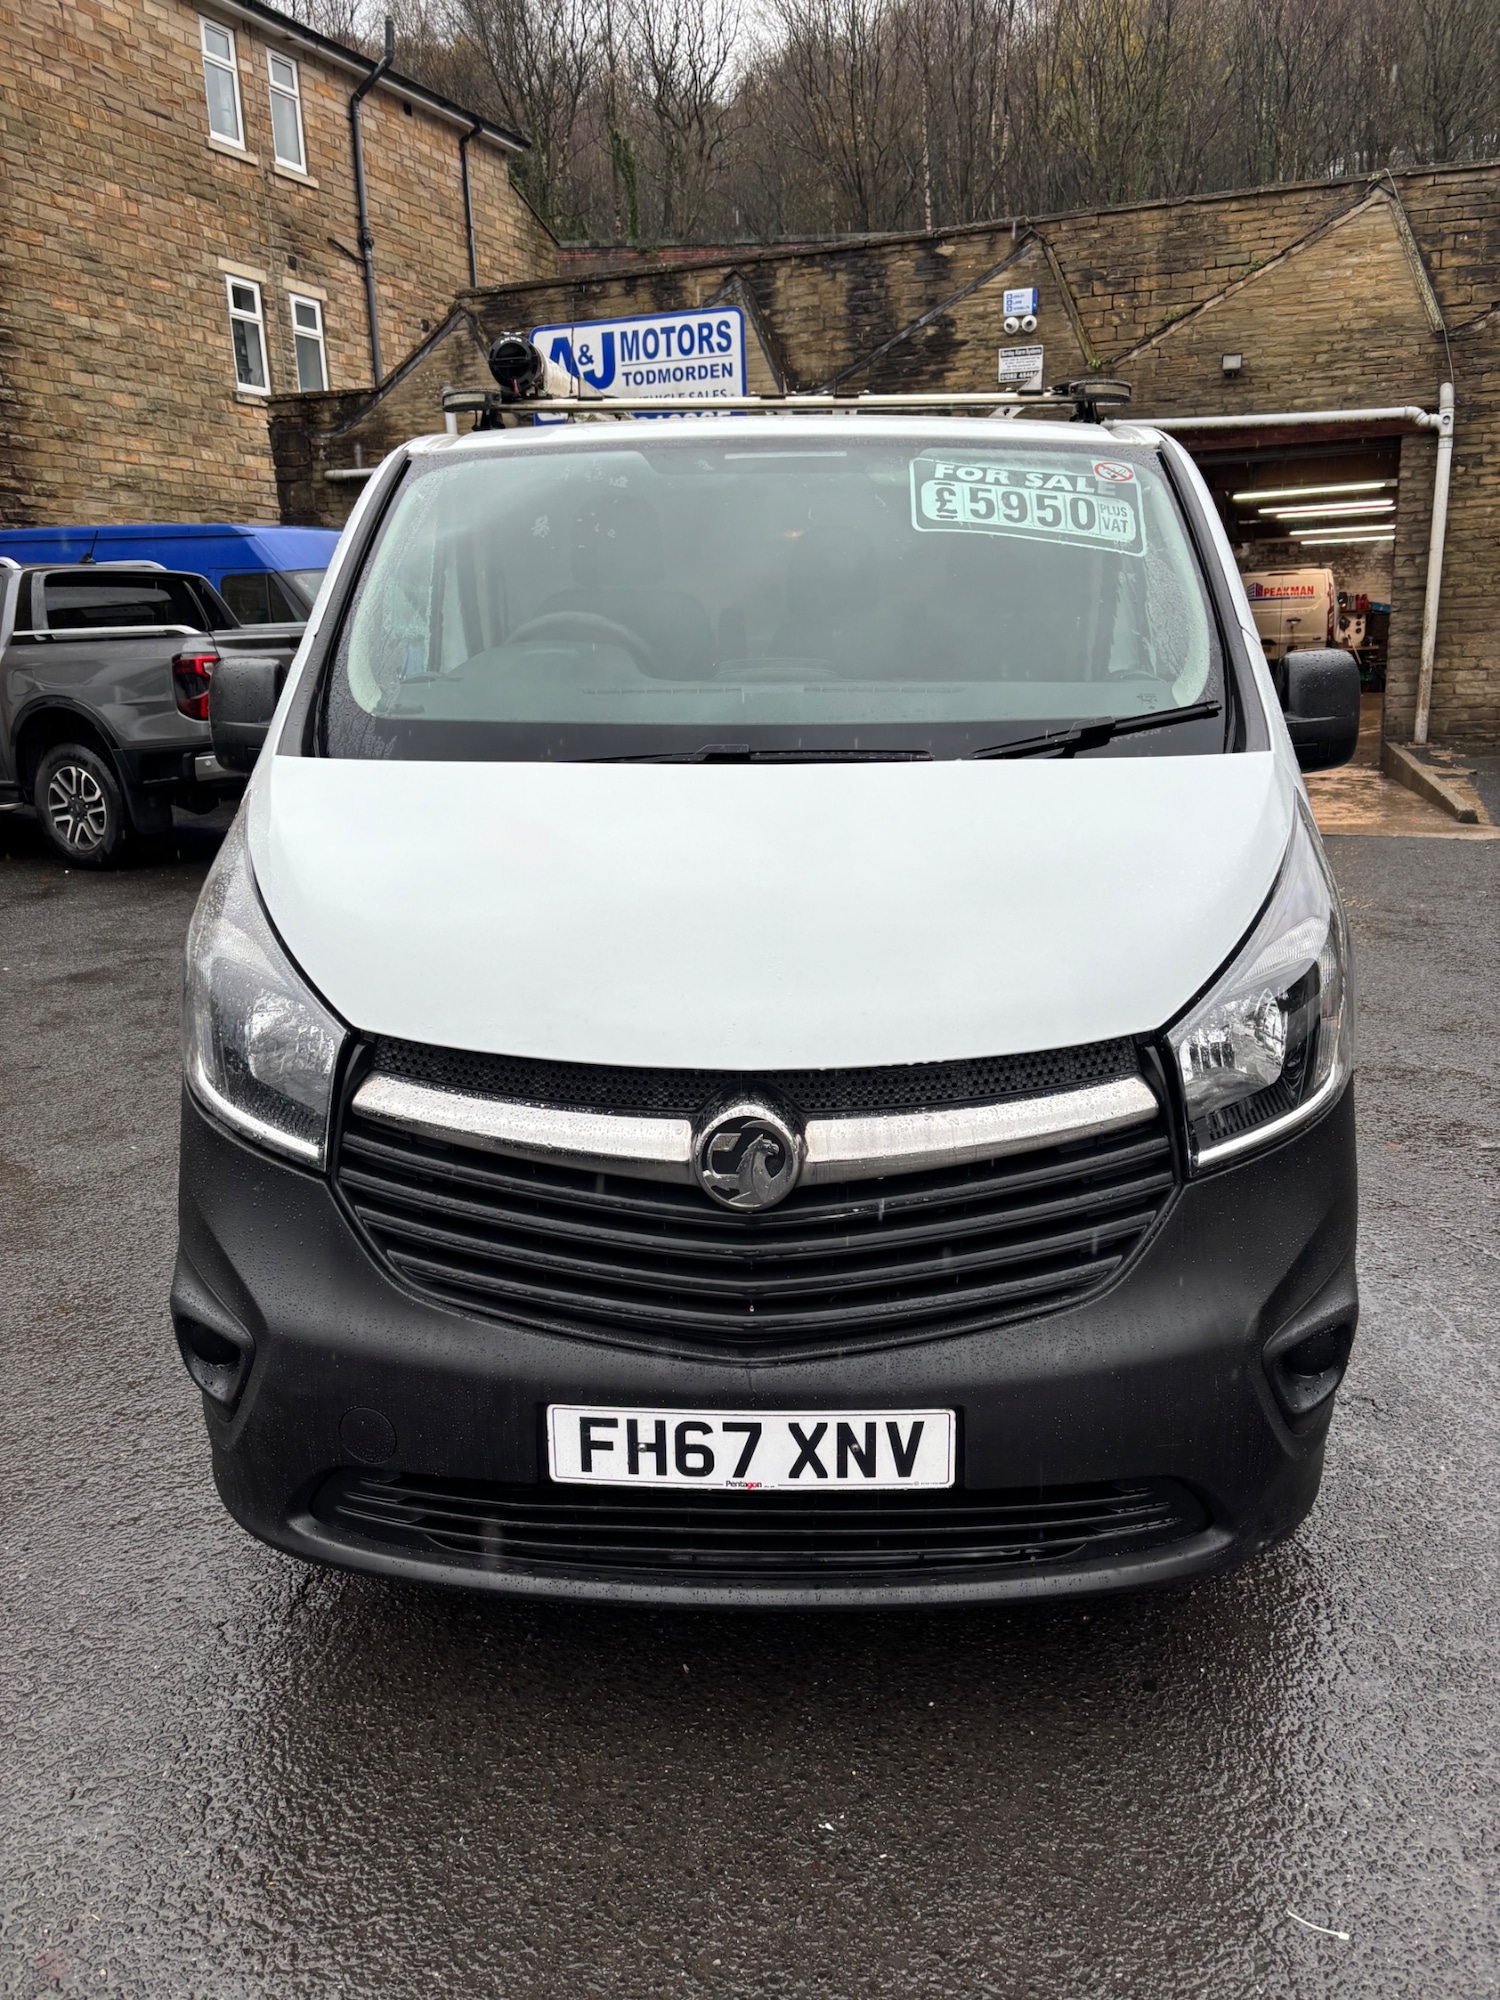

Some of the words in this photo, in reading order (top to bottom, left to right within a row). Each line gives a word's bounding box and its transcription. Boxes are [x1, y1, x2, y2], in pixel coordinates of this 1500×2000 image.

[549, 331, 616, 390] A&J
[620, 319, 733, 362] MOTORS
[621, 361, 733, 387] TODMORDEN
[934, 463, 1010, 485] FOR
[934, 481, 1096, 530] £5950
[1100, 503, 1127, 517] PLUS
[1102, 519, 1128, 534] VAT
[579, 1416, 762, 1478] FH67
[787, 1421, 925, 1479] XNV
[725, 1480, 762, 1490] Pentagon
